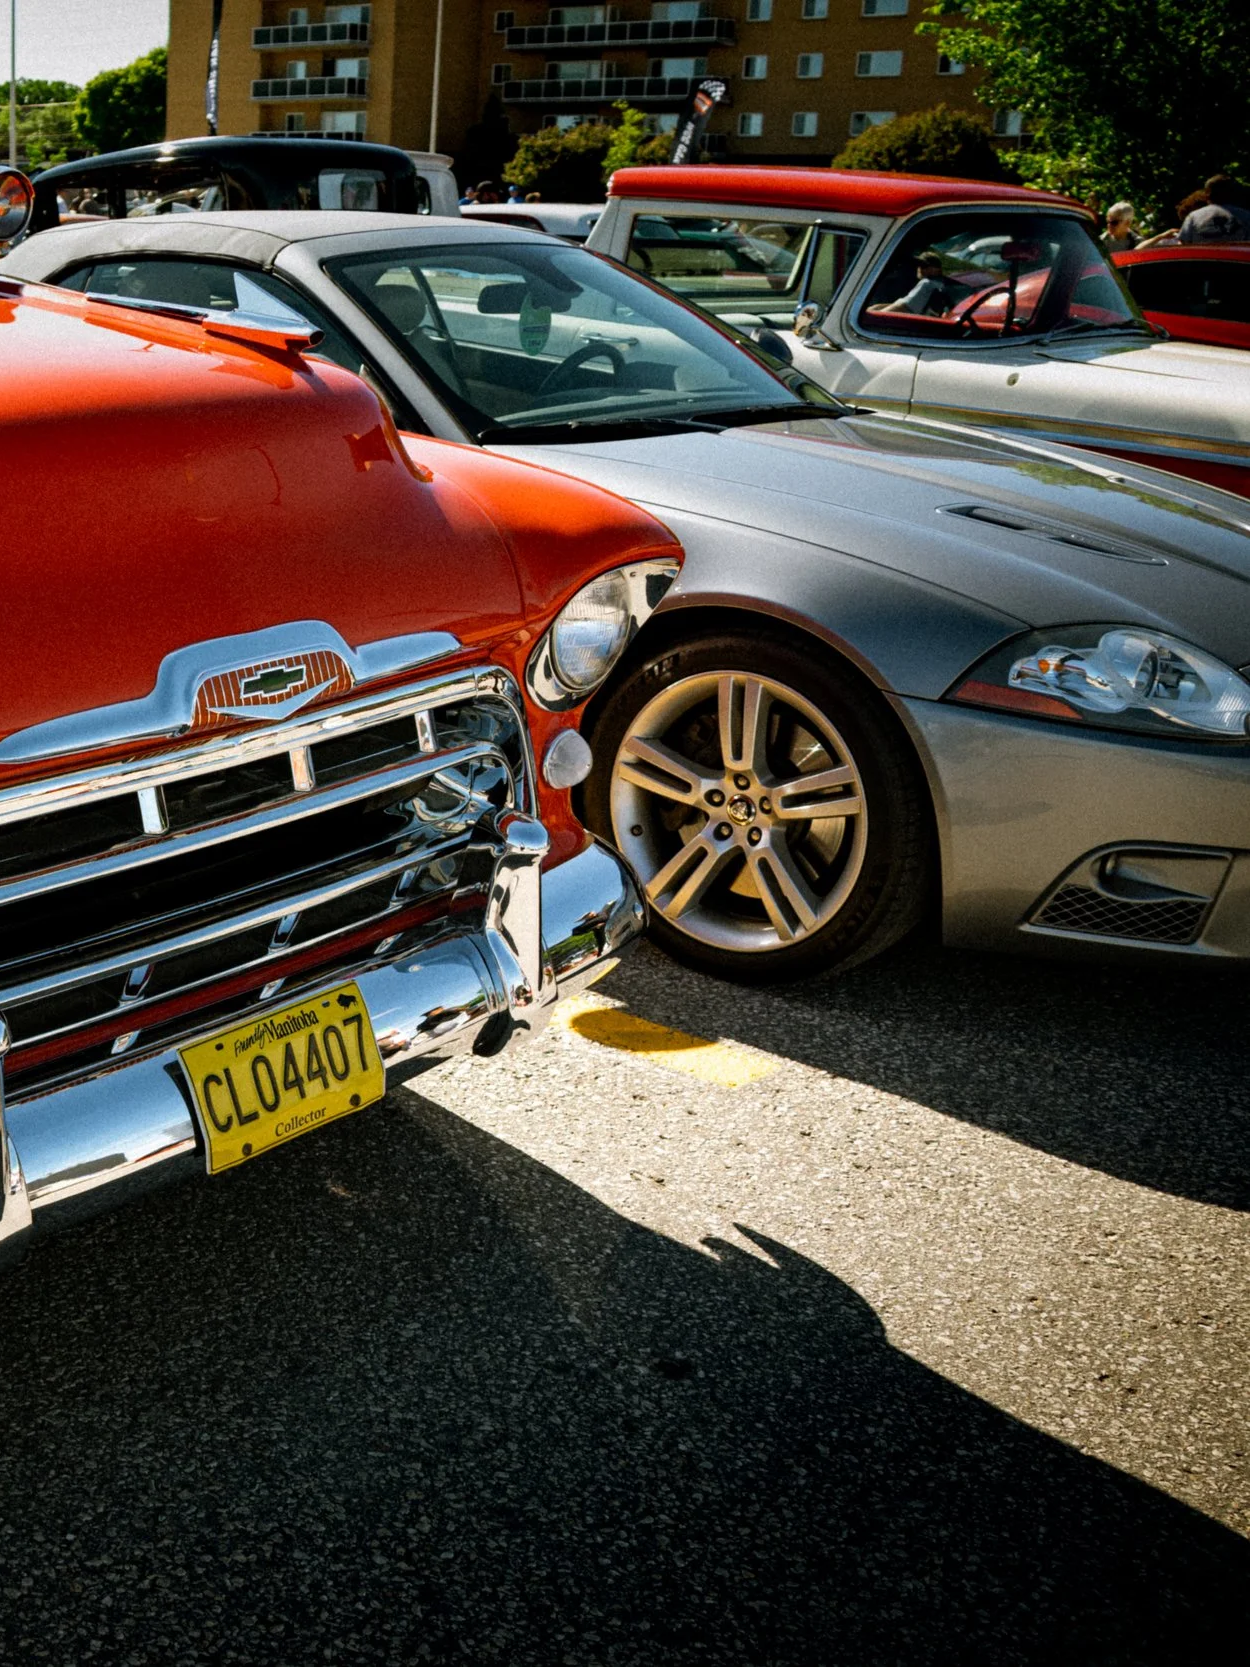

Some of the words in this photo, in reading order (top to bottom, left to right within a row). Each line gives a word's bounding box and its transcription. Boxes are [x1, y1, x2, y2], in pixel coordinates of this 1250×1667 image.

[234, 1025, 267, 1057] Friendly
[262, 1009, 319, 1044] Manitoba
[274, 1107, 327, 1137] Collector
